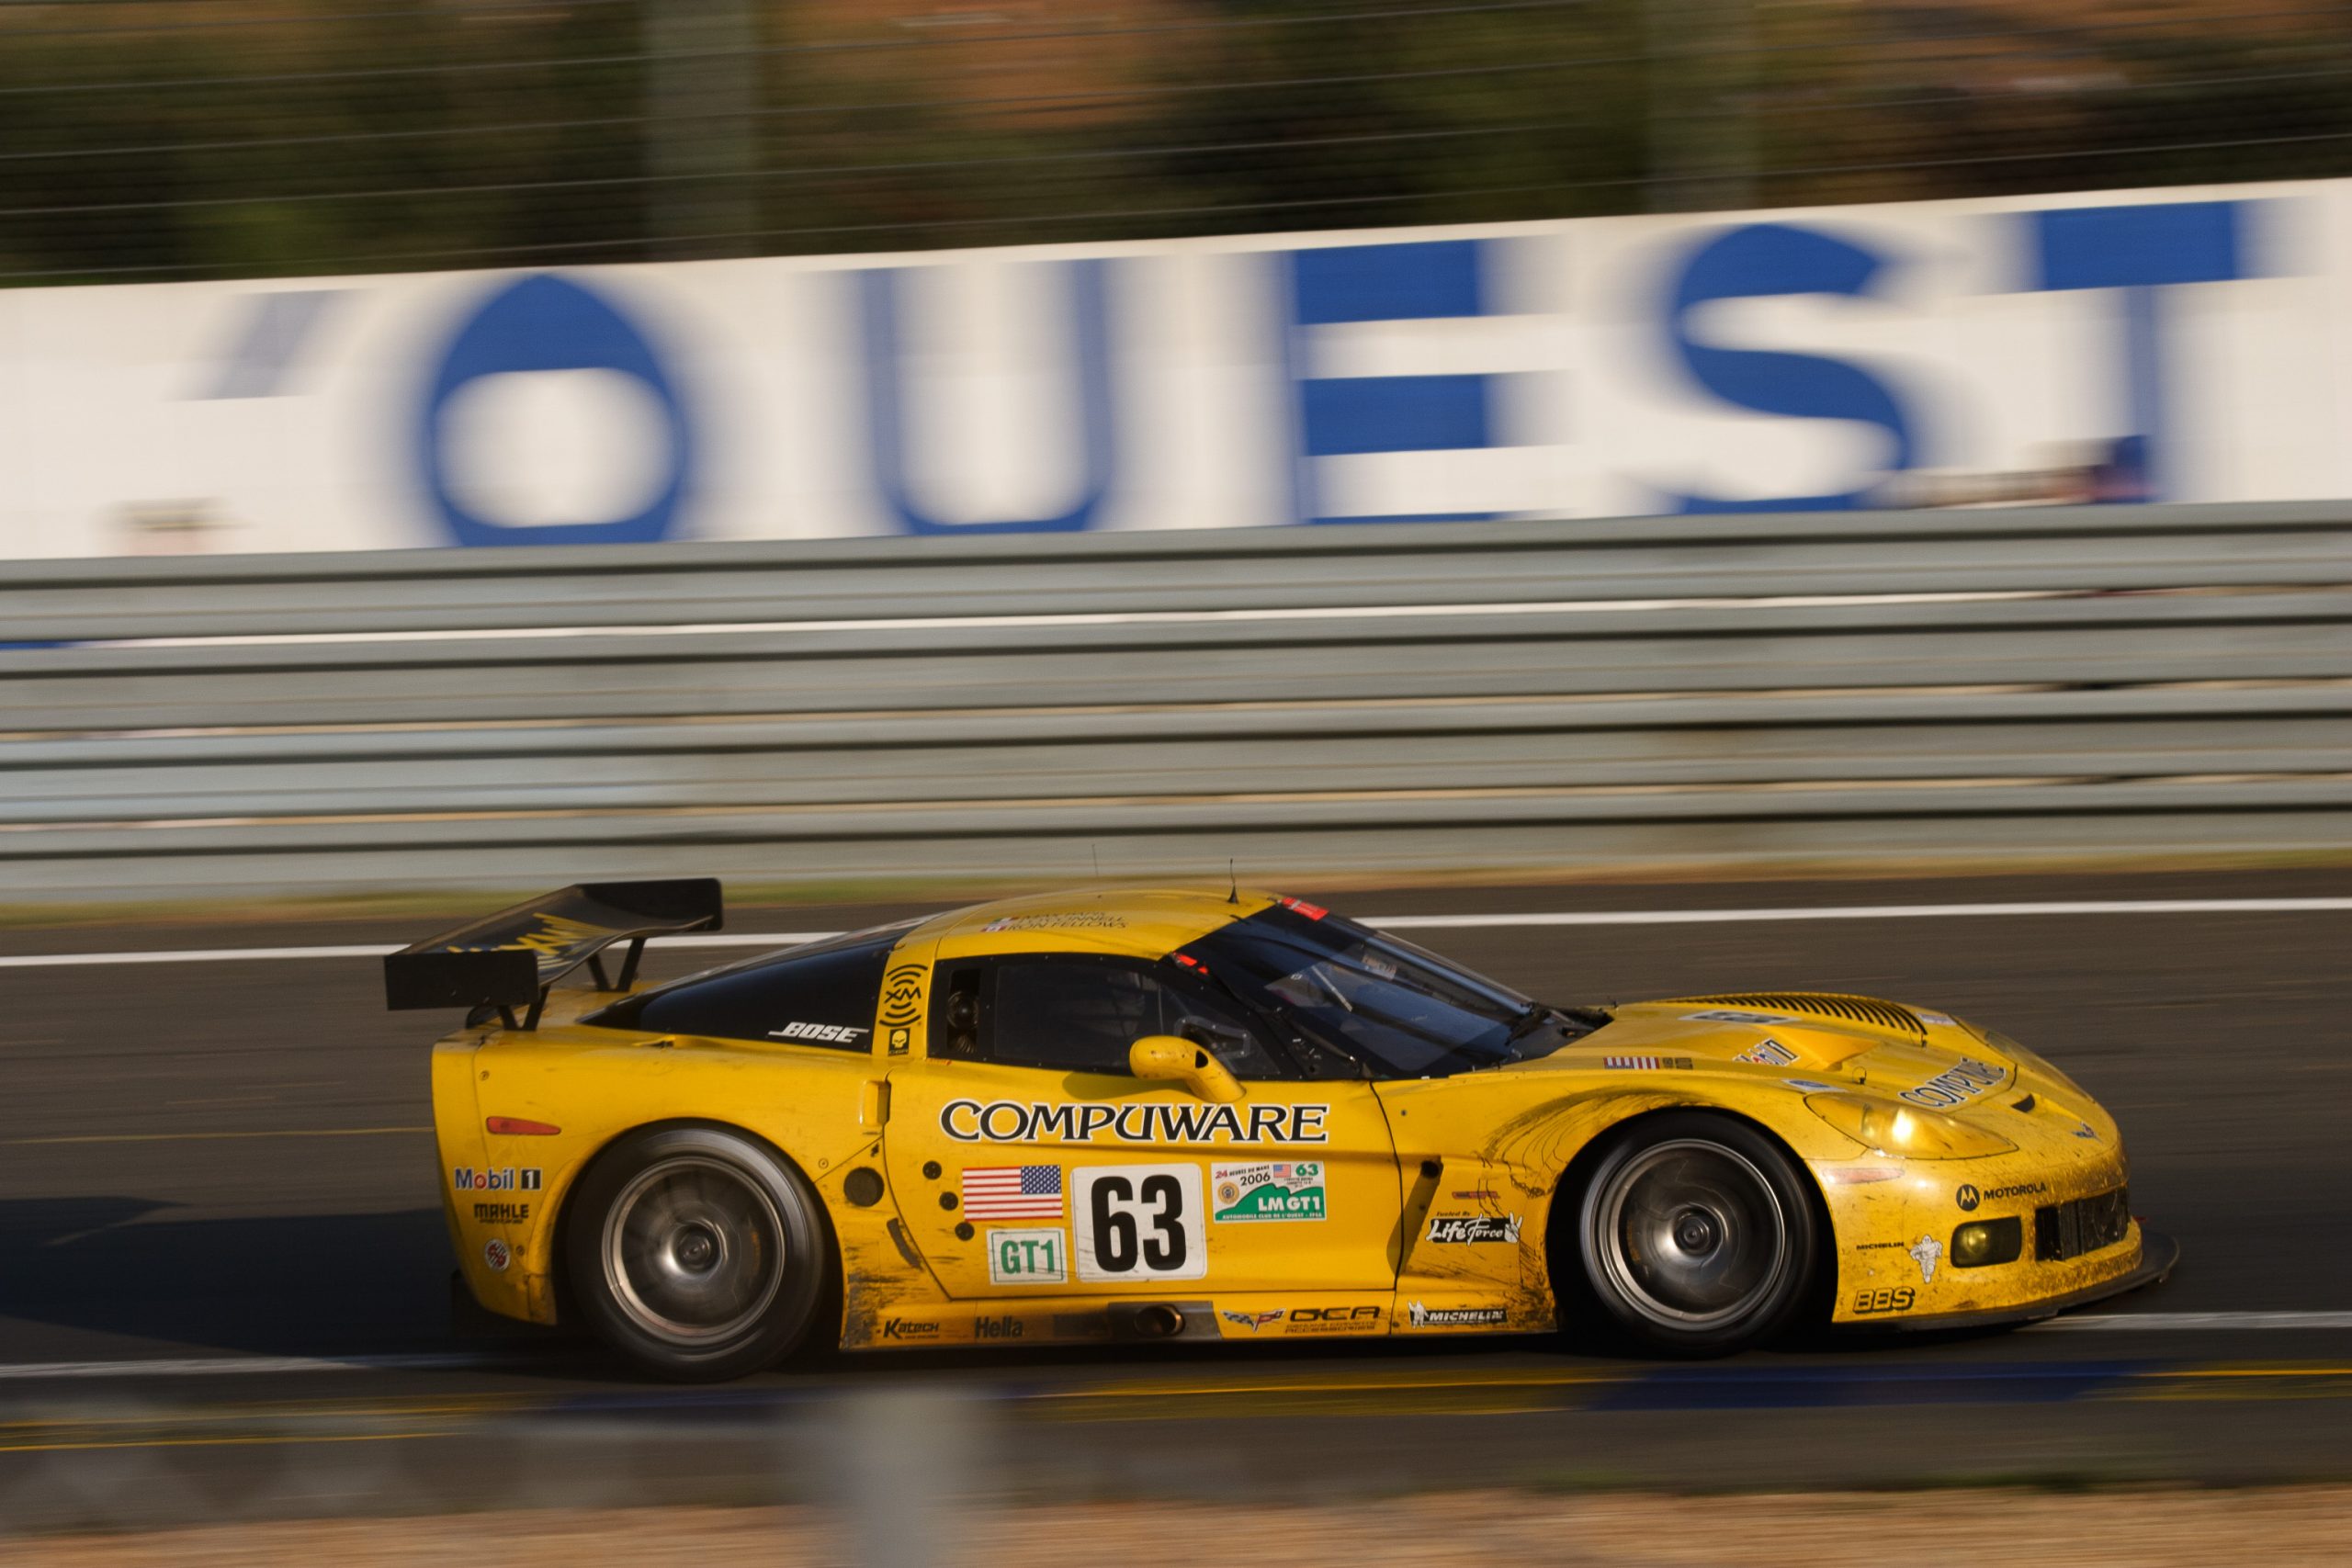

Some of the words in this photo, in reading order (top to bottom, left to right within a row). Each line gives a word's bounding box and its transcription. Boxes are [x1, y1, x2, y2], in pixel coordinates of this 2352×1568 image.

[884, 987, 922, 1003] XM
[768, 1021, 869, 1043] BOSE
[940, 1100, 1329, 1144] COMPUWARE
[455, 1168, 515, 1190] Mobil
[1215, 1169, 1228, 1179] 24
[1240, 1172, 1271, 1186] 2006
[1295, 1163, 1318, 1177] 63
[1984, 1182, 2047, 1201] MOTOROLA
[474, 1203, 529, 1219] MAHLE
[1091, 1174, 1187, 1272] 63
[1856, 1241, 1905, 1250] MICHELIN
[1001, 1238, 1056, 1275] GT1
[1853, 1286, 1916, 1314] BBS
[1430, 1310, 1504, 1322] MICHELIN
[974, 1315, 1023, 1338] Hella
